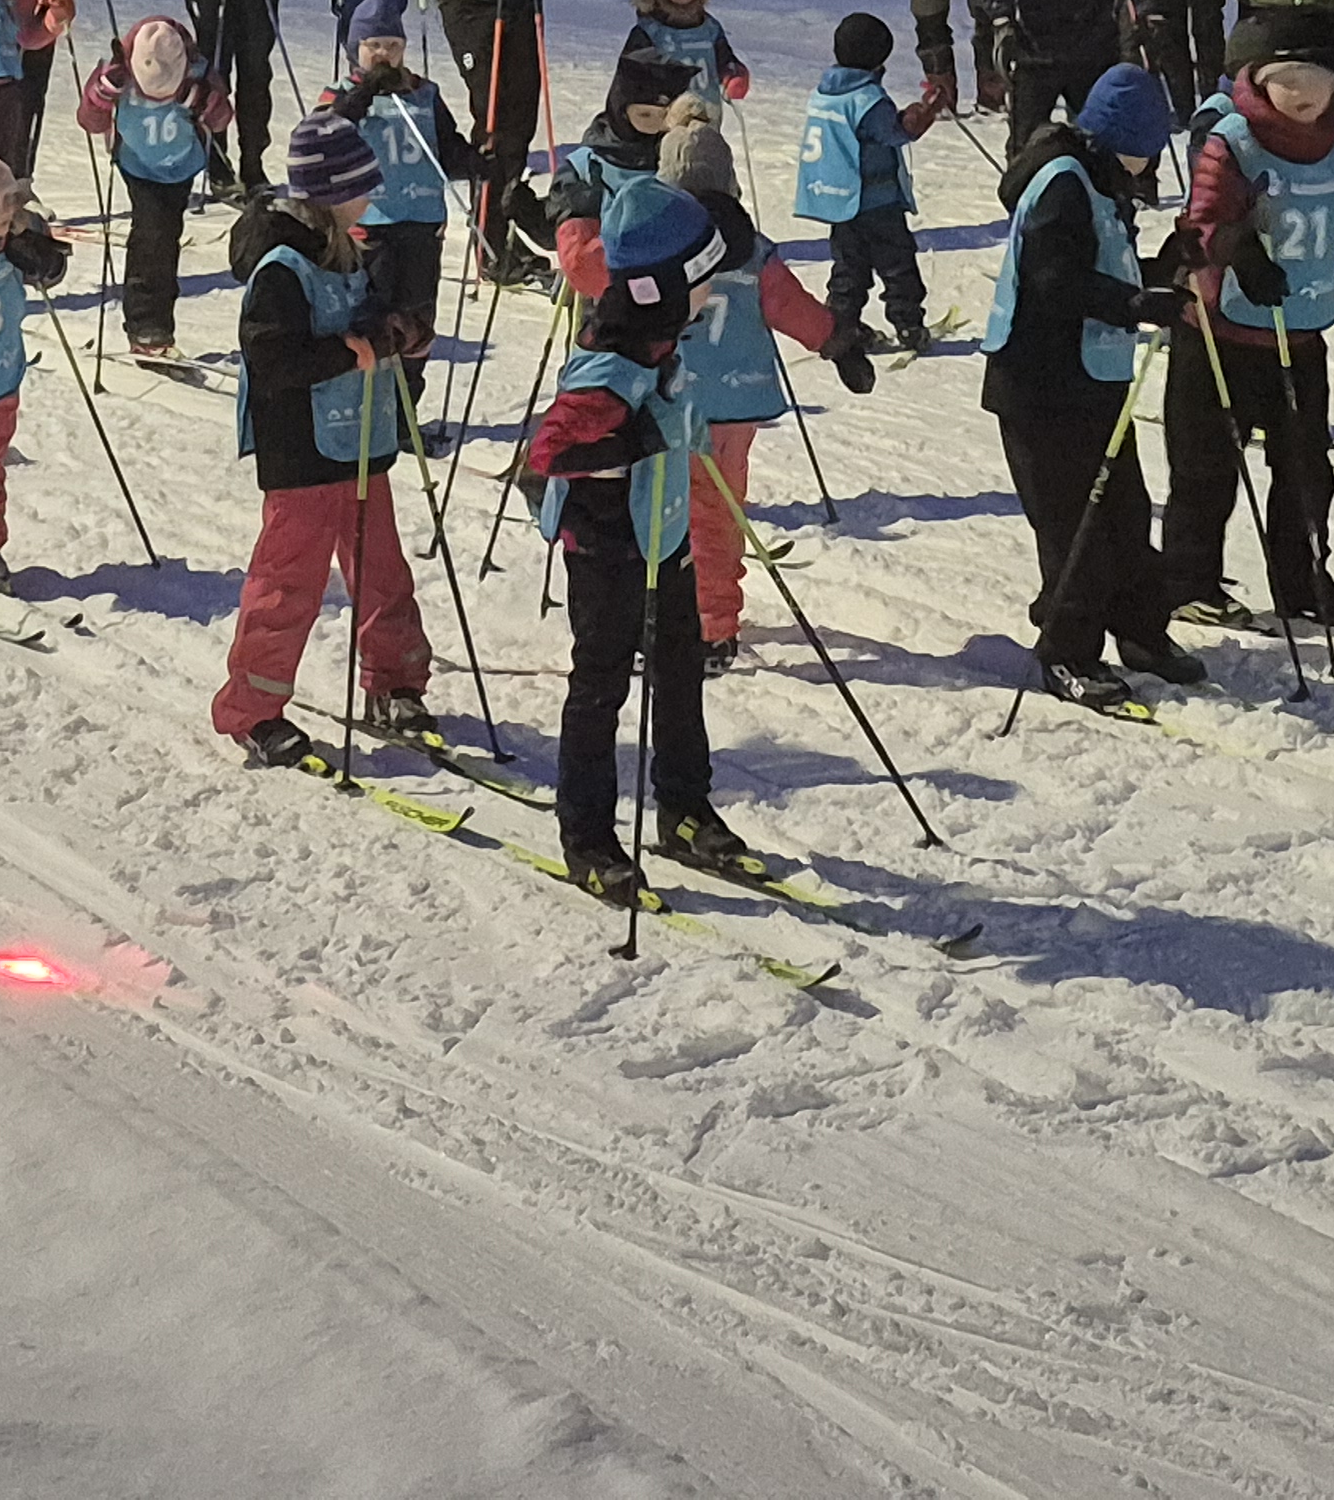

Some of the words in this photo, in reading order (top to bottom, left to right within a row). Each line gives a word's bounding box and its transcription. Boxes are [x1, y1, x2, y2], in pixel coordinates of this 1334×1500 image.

[141, 109, 178, 146] 16
[382, 124, 424, 165] 15
[801, 125, 823, 163] 5
[1280, 205, 1329, 260] 21
[706, 294, 729, 347] 7
